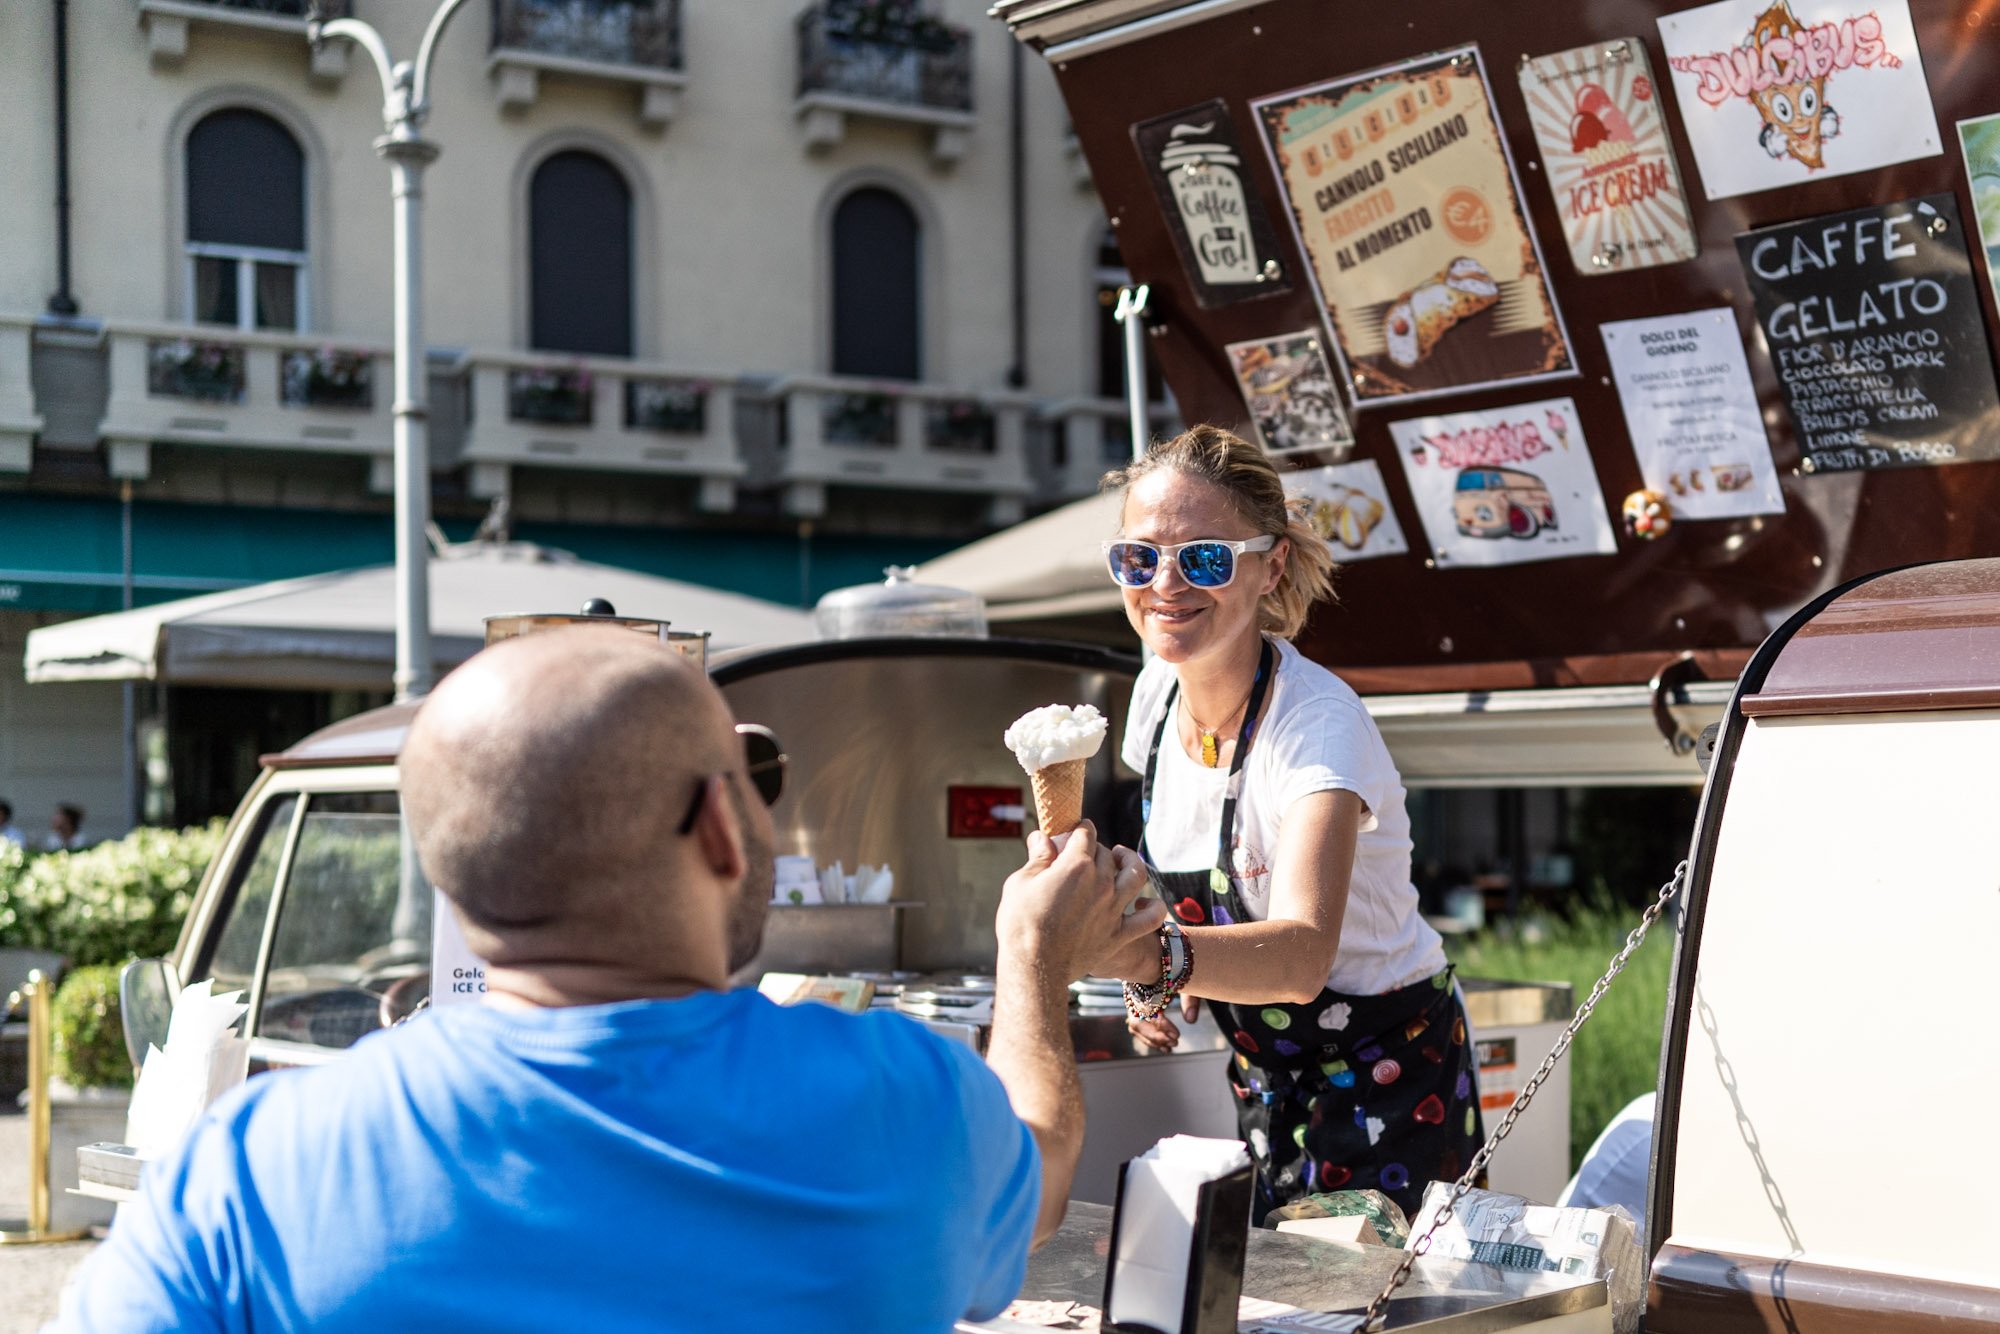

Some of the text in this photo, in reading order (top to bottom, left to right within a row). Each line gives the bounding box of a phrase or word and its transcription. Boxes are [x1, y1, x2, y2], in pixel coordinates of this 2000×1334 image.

[1315, 113, 1469, 213] CANNOLO SICILIANO
[1569, 180, 1602, 219] ICE
[1602, 158, 1671, 208] CREAM
[1181, 190, 1241, 223] Coffee
[1323, 187, 1396, 243] FARCITO
[1199, 231, 1248, 271] Go!
[1336, 206, 1433, 272] AL MOMENTO
[1768, 277, 1948, 343] GELATO
[1640, 327, 1700, 344] DOLCI DEL
[1646, 341, 1698, 357] GIORNO
[1778, 328, 1940, 369] FIOR D'ARANCIO
[1781, 351, 1946, 383] CIOCCOLATO DARK
[1789, 373, 1894, 400] PISTACCHIO
[1791, 387, 1927, 415] STRACCIATELLA
[1800, 402, 1939, 432] BAILEYS CREAM
[1806, 428, 1869, 450] LIMONE
[1867, 449, 1890, 466] DI
[453, 982, 473, 993] ICE
